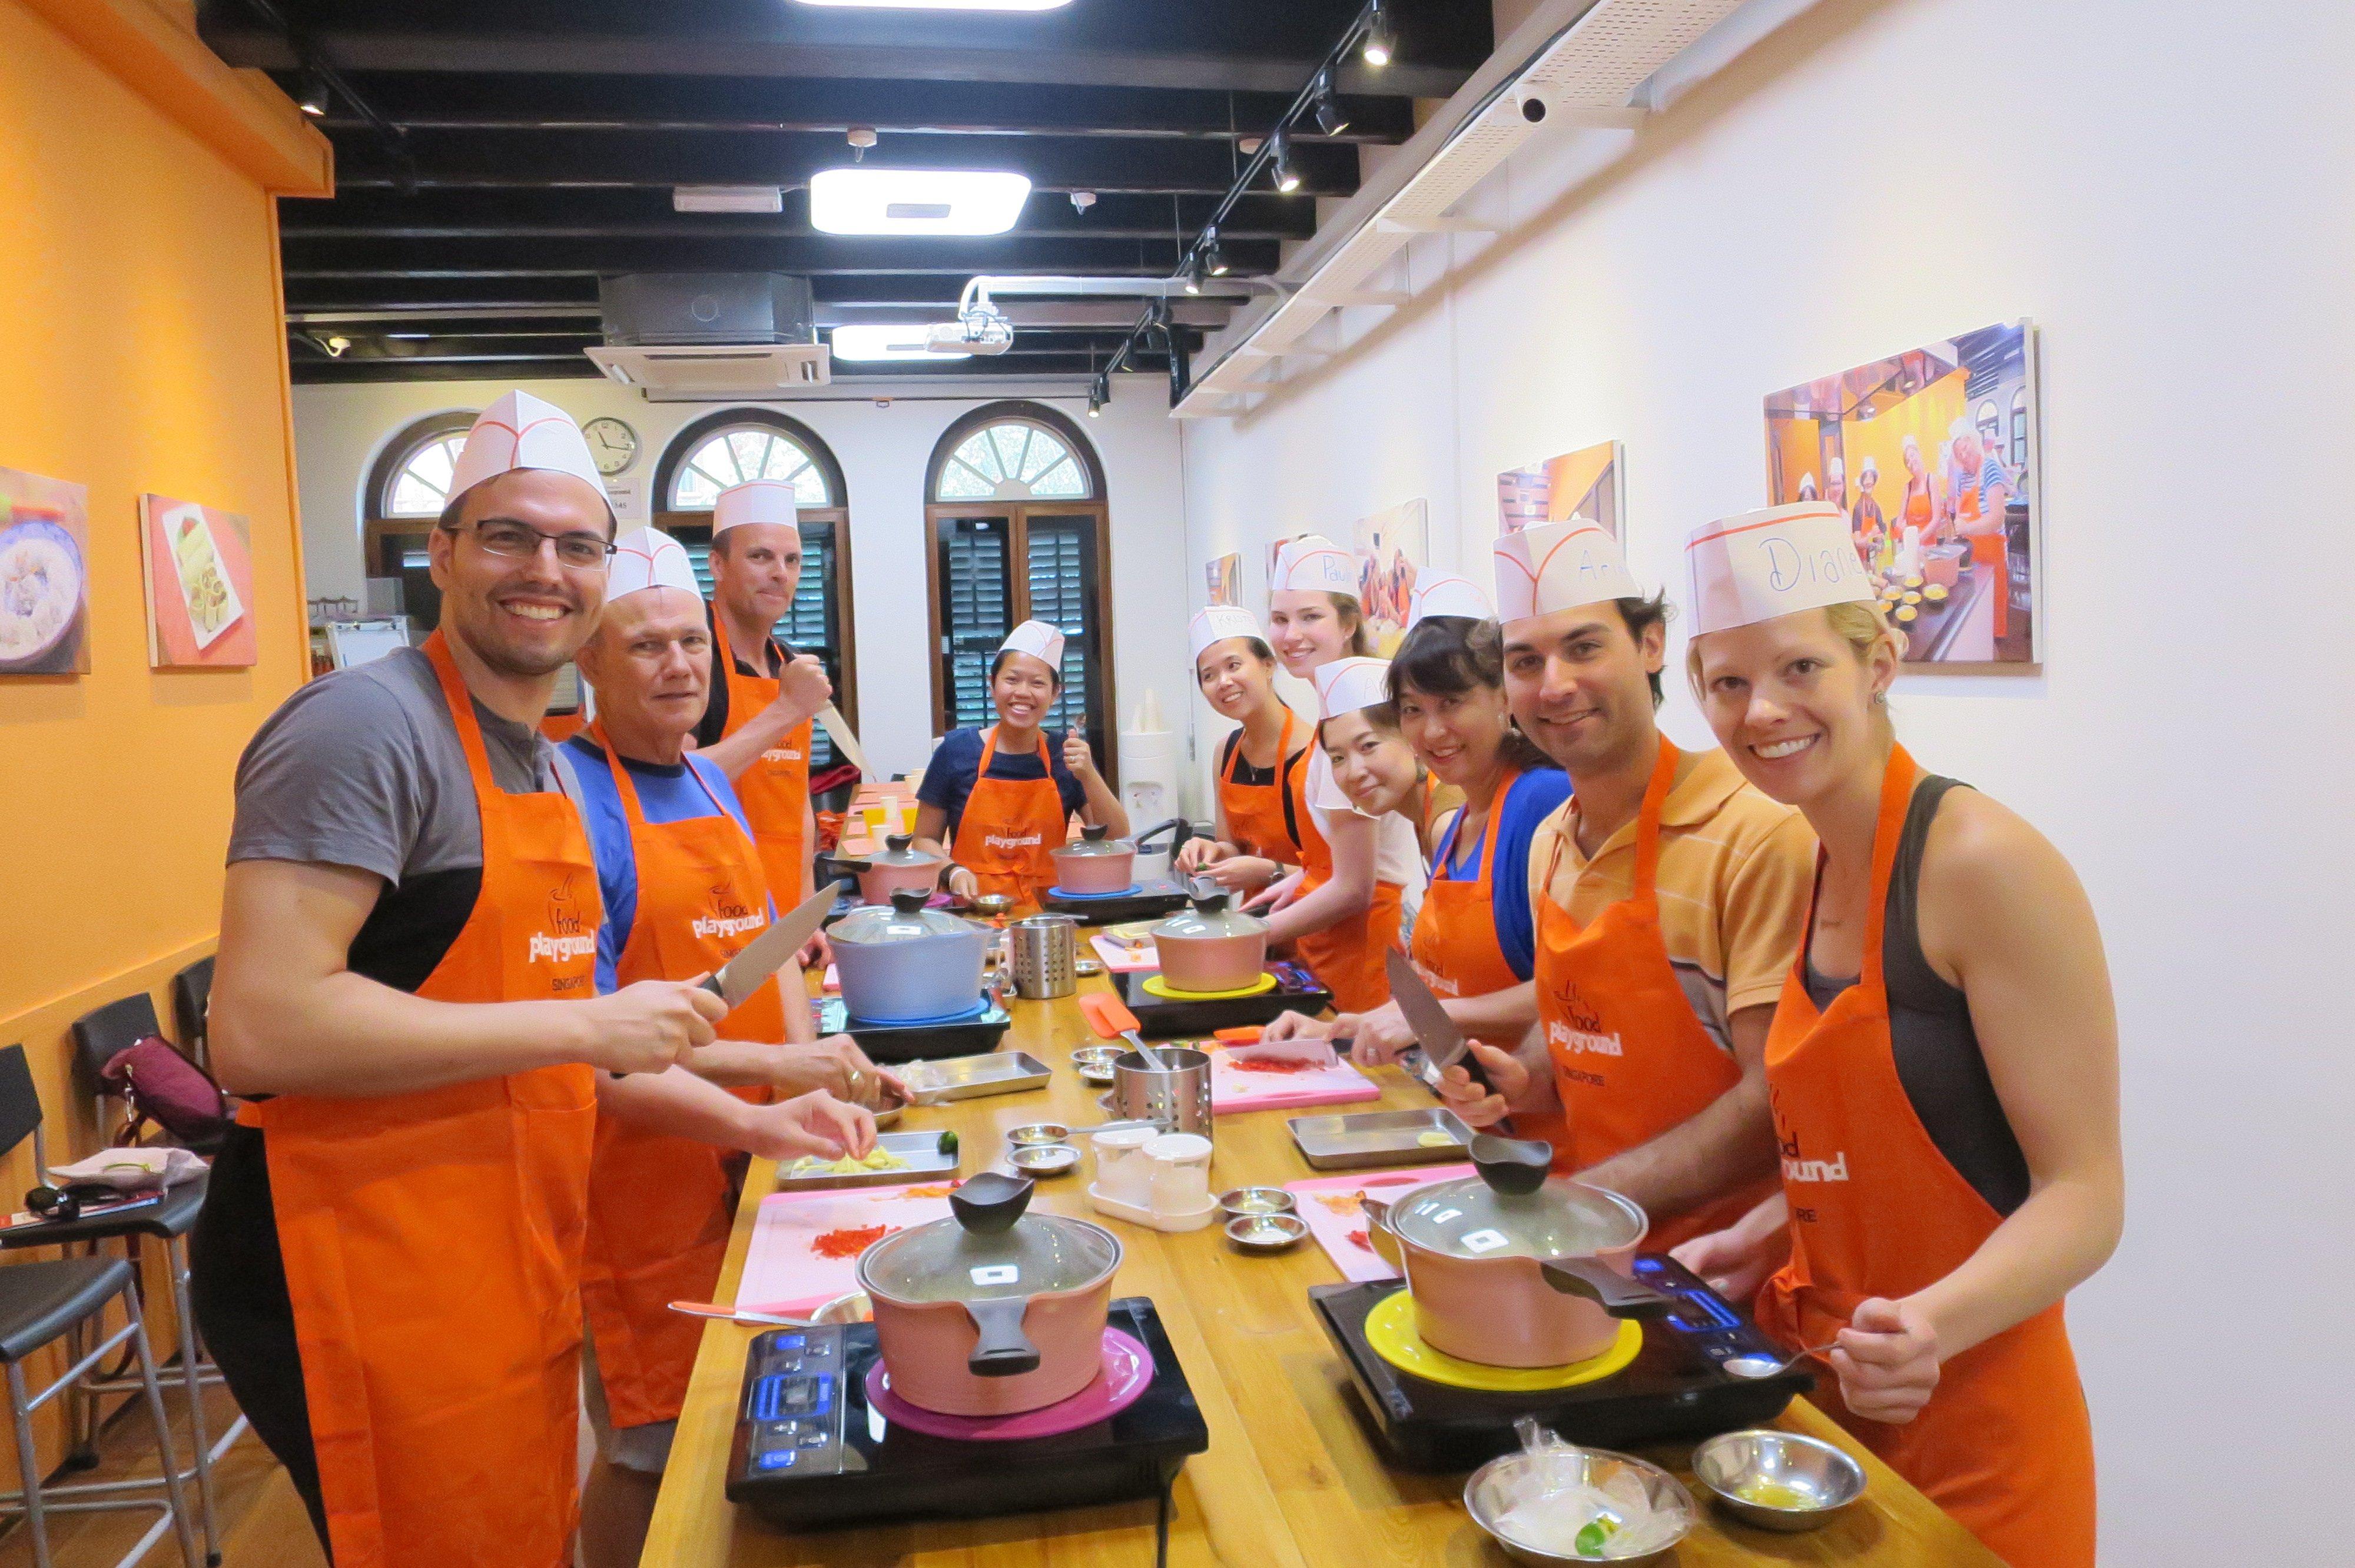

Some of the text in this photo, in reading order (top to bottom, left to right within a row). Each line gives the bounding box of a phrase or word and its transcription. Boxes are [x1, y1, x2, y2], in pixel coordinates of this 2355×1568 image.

[1759, 537, 1862, 592] Diane
[984, 833, 1041, 849] playground
[692, 907, 764, 939] playground
[529, 928, 595, 963] playground
[1549, 1020, 1623, 1057] playground
